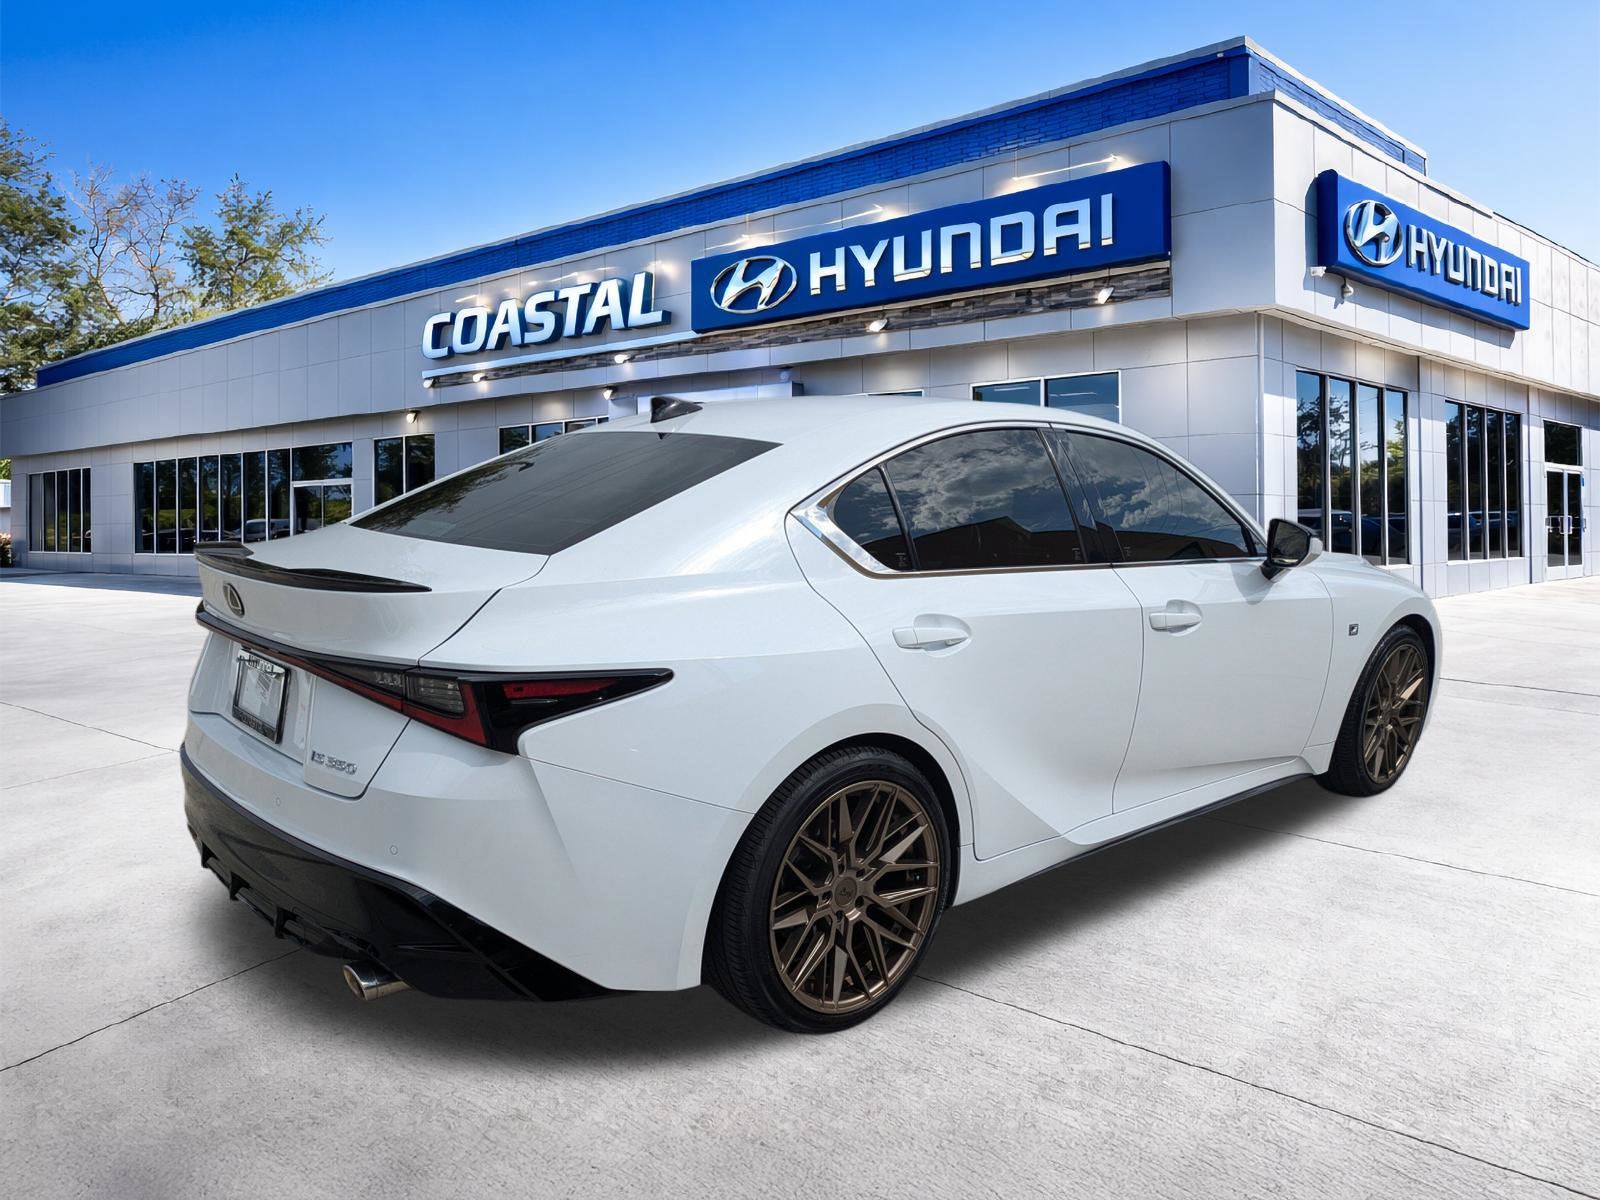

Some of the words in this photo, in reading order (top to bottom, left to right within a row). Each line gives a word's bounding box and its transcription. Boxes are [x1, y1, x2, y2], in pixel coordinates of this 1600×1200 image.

[809, 192, 1113, 295] HYUNDAI
[1406, 224, 1522, 306] HYUNDAI
[422, 271, 667, 359] COASTAL
